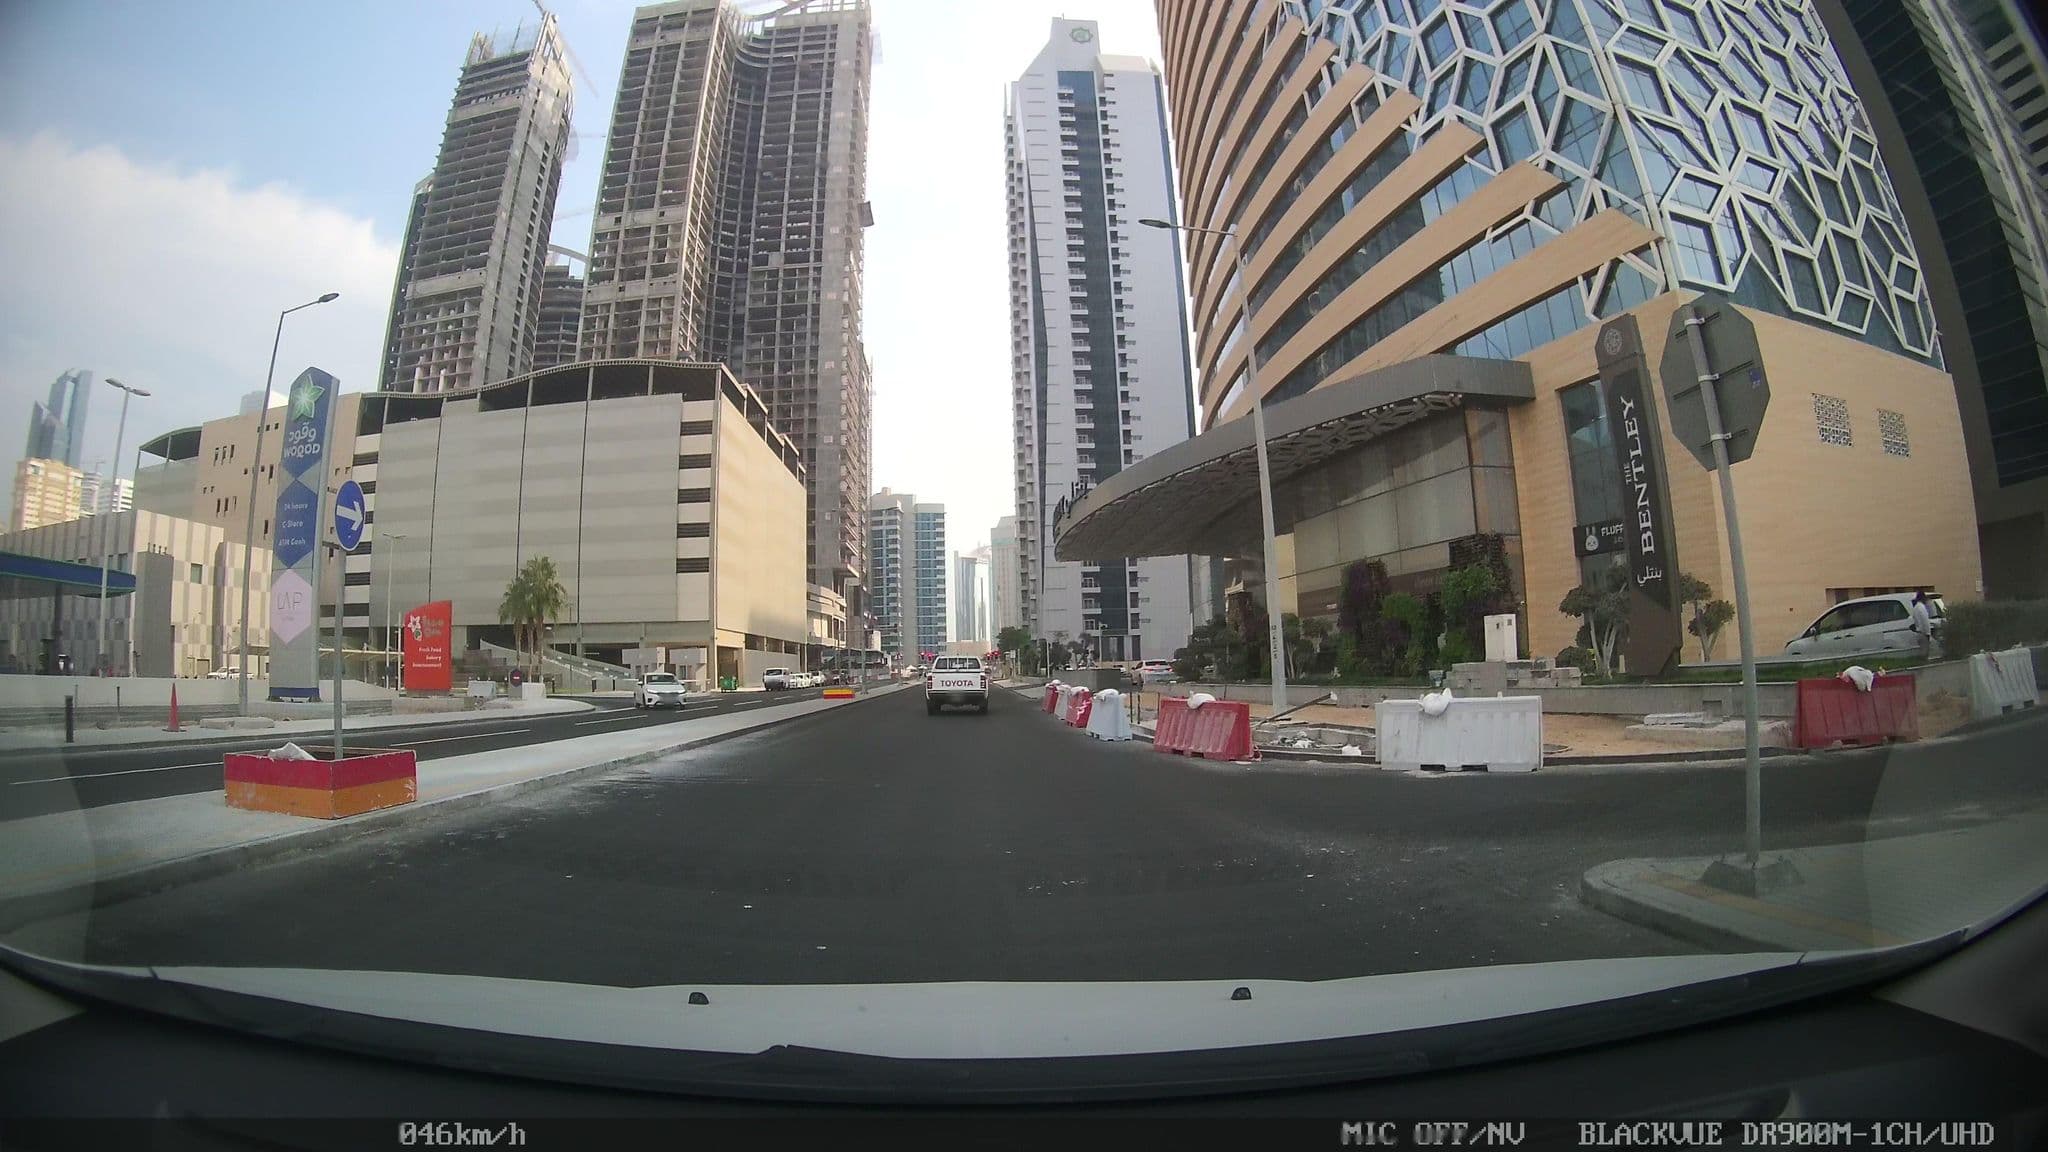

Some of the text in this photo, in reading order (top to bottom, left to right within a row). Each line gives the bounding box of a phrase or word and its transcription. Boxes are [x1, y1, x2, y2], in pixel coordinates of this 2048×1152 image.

[284, 443, 320, 458] WOQOD
[1620, 395, 1655, 555] BENTLEY
[1624, 463, 1632, 485] THE
[1637, 566, 1662, 587] بنتلي
[941, 680, 974, 688] TOYOTA
